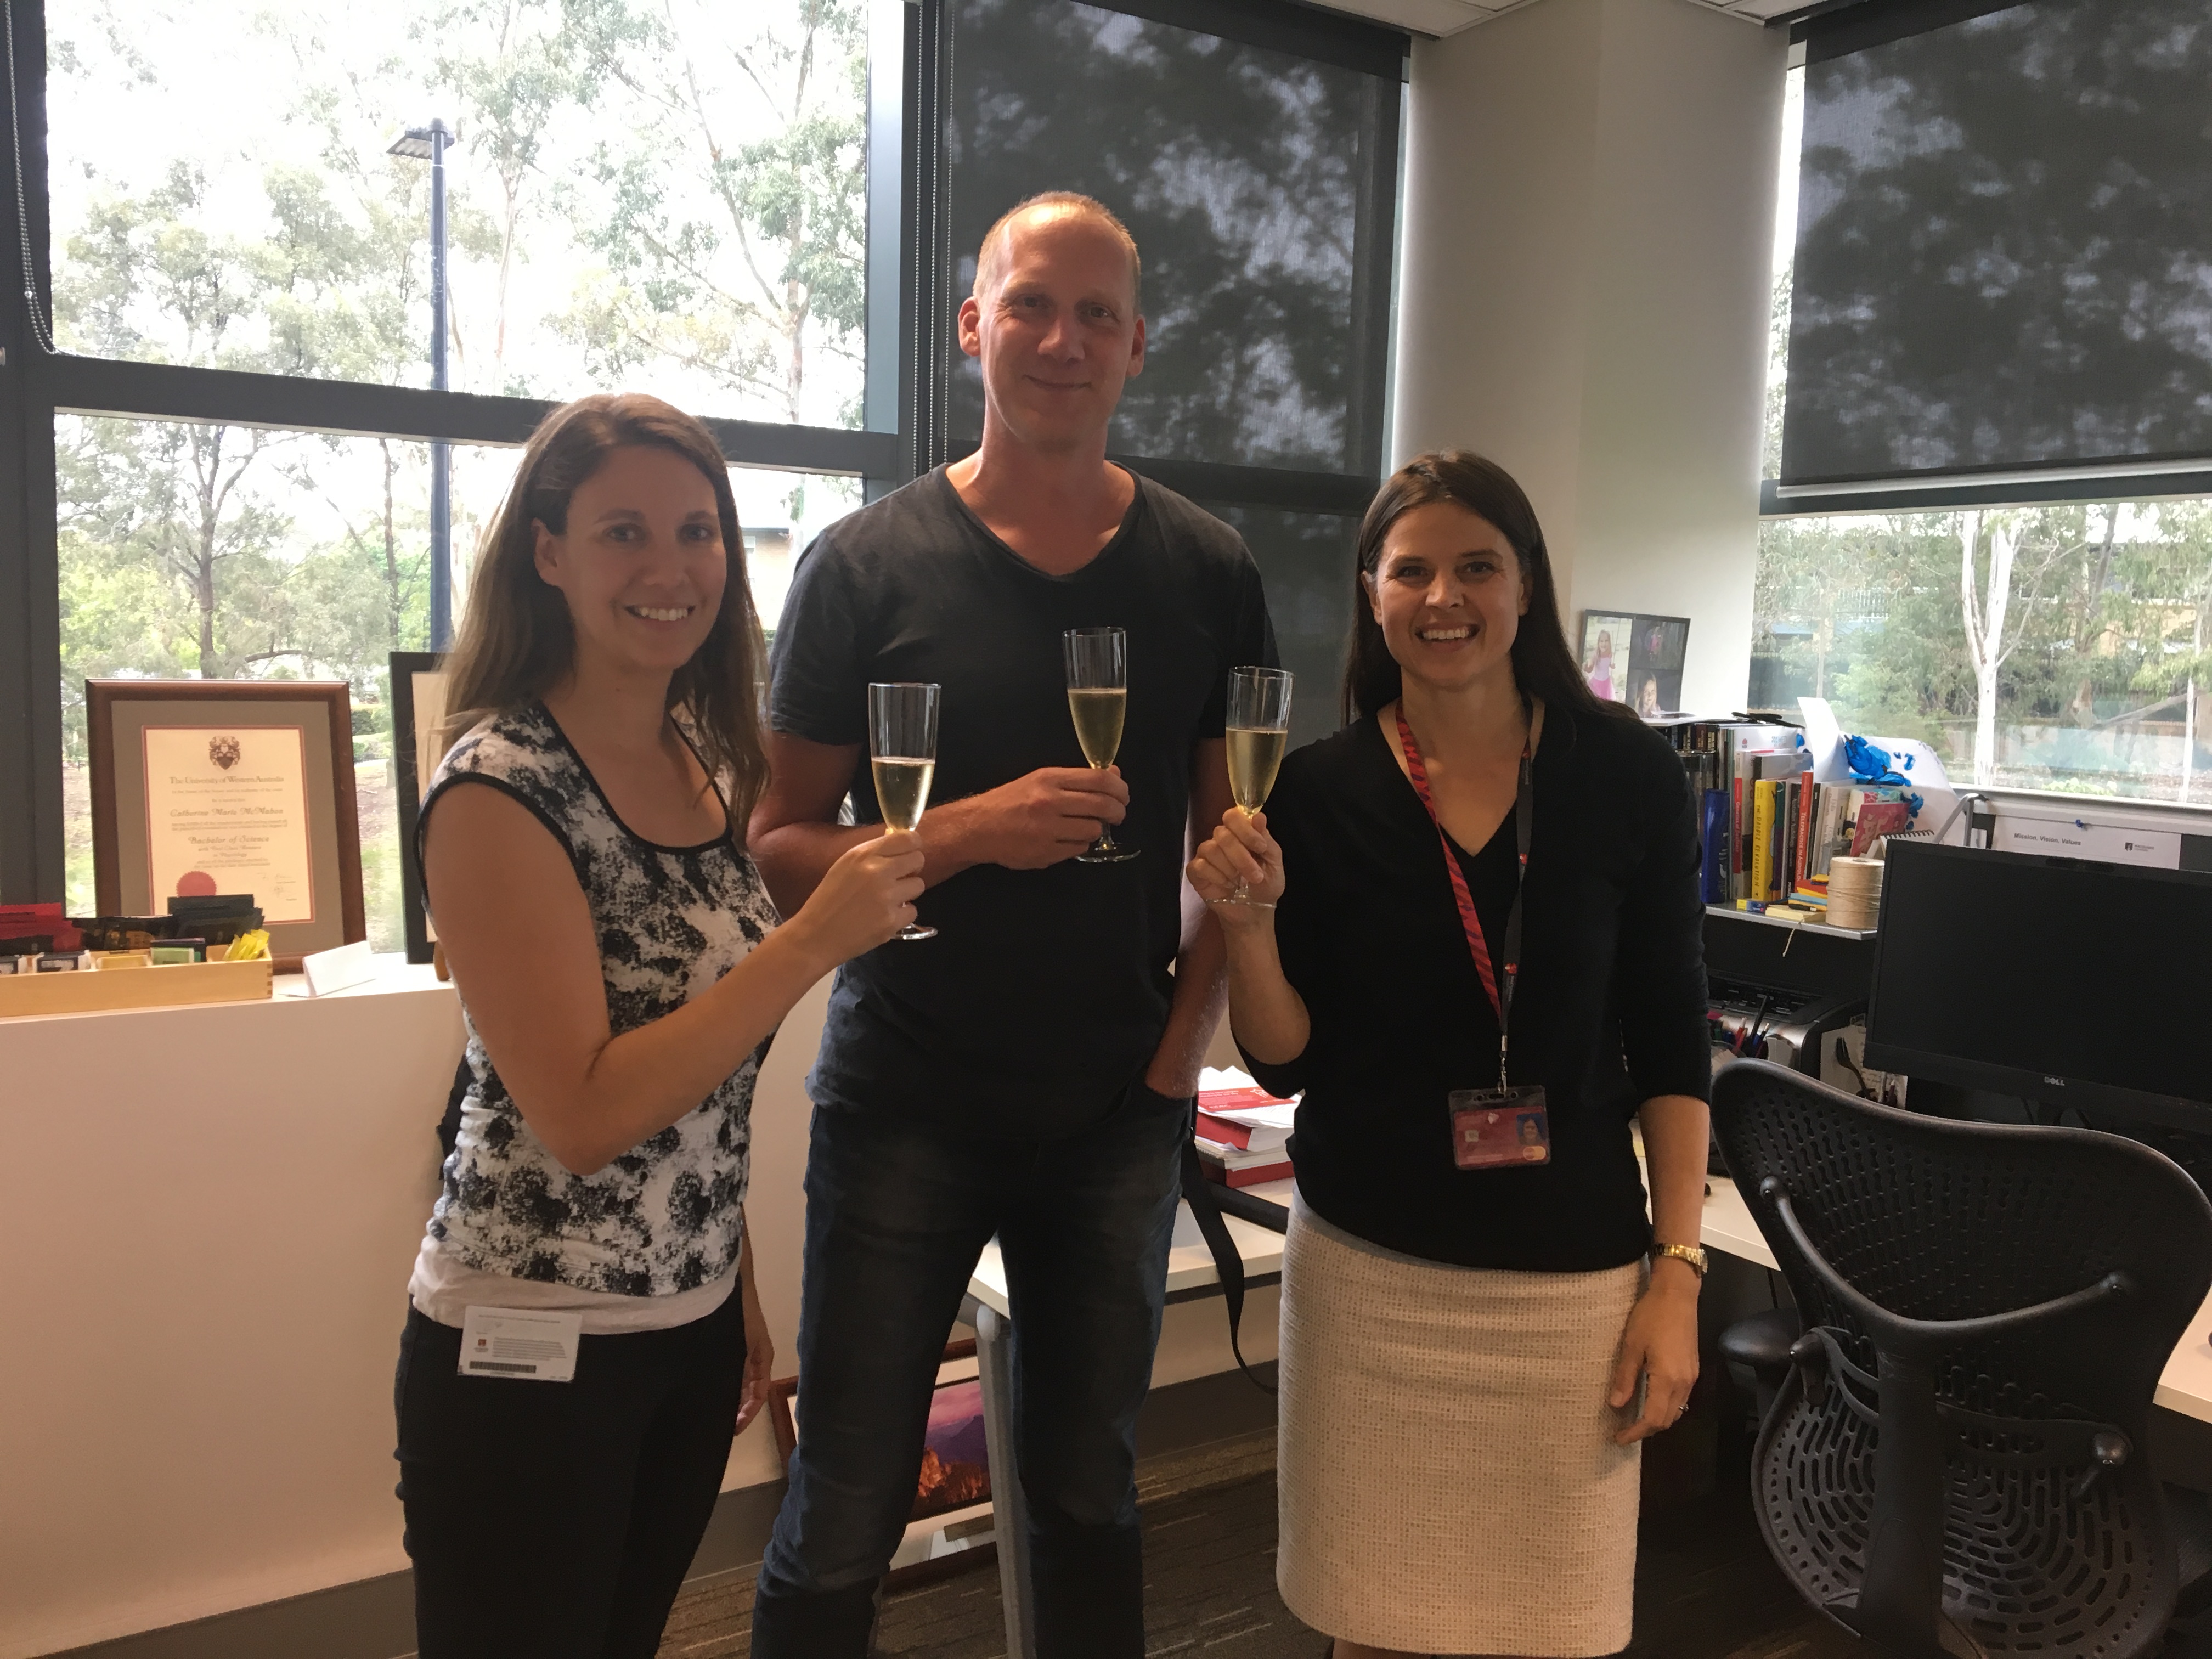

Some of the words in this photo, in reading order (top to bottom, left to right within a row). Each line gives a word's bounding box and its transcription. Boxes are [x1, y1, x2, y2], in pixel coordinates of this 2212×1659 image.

[184, 776, 218, 785] University
[212, 808, 238, 816] Marie
[240, 806, 284, 815] McMahon
[188, 836, 225, 844] Bachelor
[228, 836, 238, 844] of
[239, 834, 269, 843] Science
[2044, 1076, 2065, 1086] DELL
